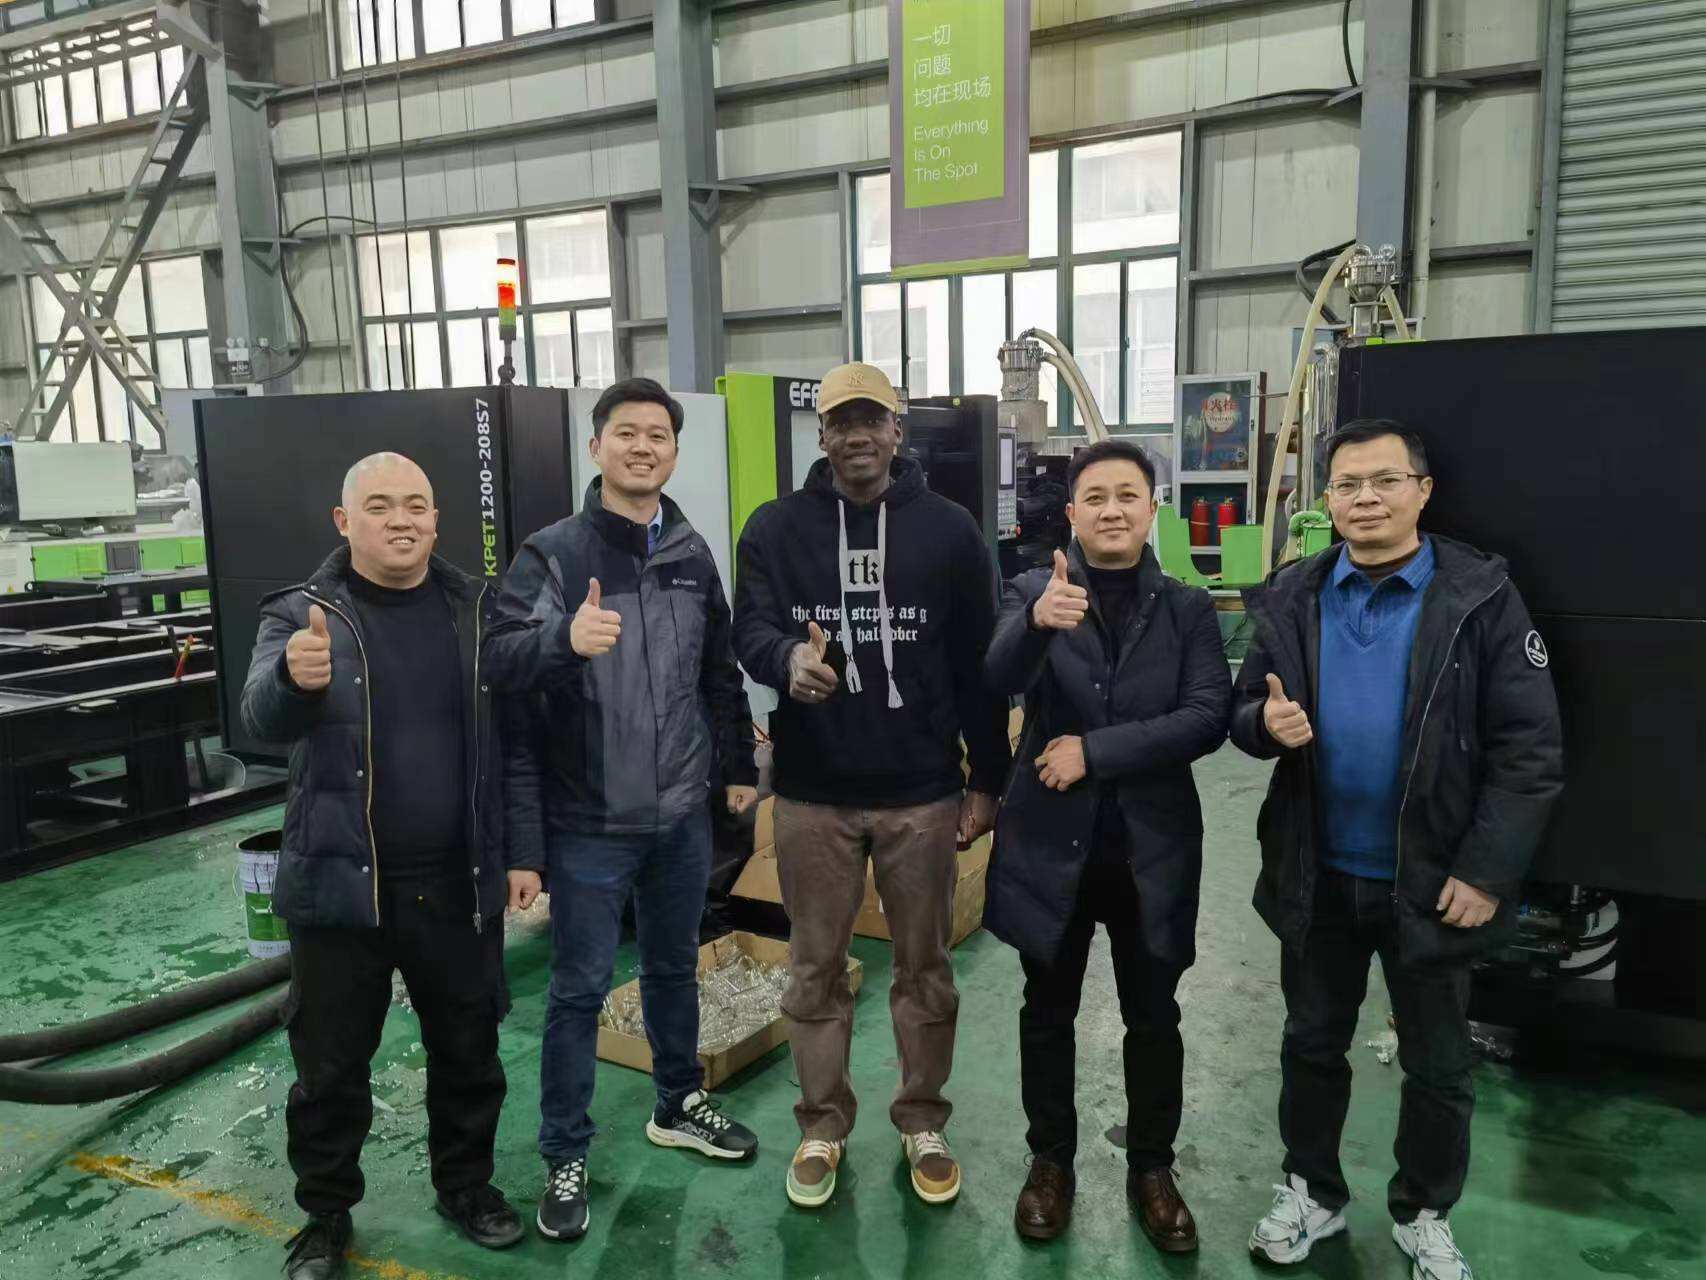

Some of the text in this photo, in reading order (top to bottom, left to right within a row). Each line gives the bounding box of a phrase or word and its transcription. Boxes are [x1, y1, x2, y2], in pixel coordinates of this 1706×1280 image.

[911, 23, 951, 46] 一切
[913, 54, 952, 80] 问题
[912, 74, 992, 107] 均在现场
[914, 119, 989, 142] Everything
[929, 144, 951, 160] On
[914, 162, 978, 184] The Spot
[475, 398, 498, 577] KPET1200-208S7
[792, 605, 811, 623] the
[815, 604, 842, 621] firs
[899, 606, 916, 620] as
[856, 626, 882, 644] hal
